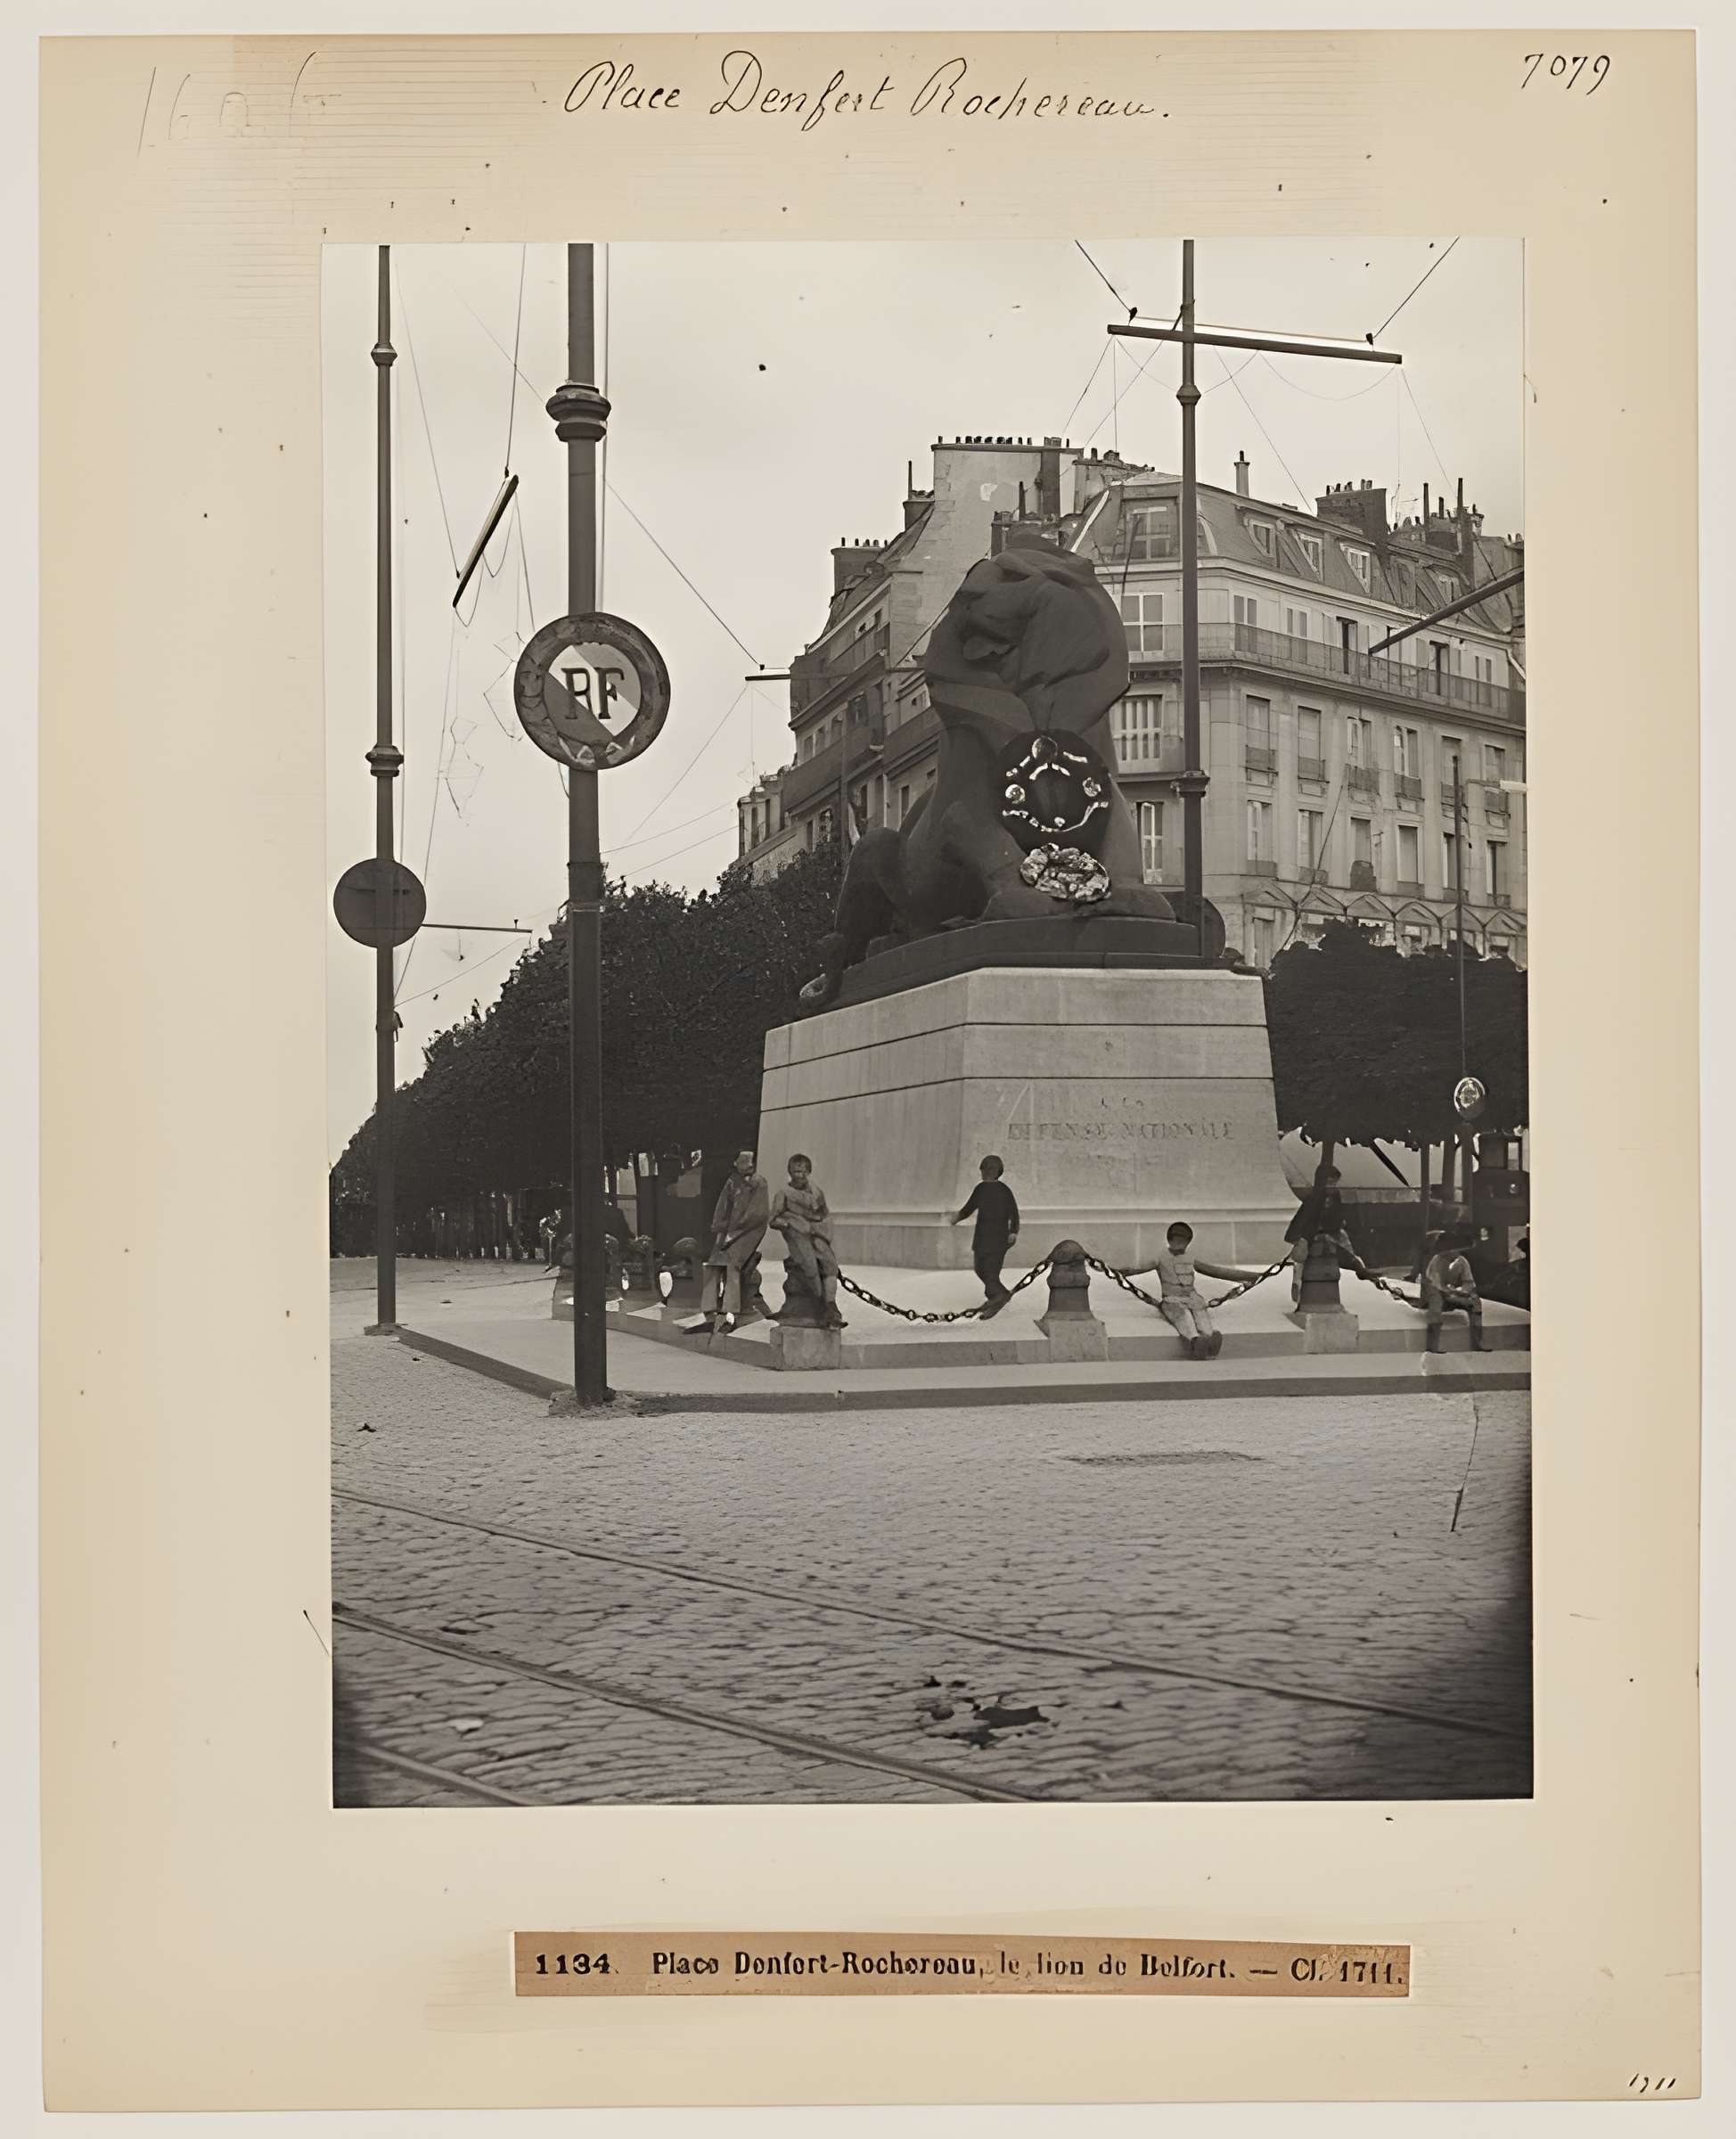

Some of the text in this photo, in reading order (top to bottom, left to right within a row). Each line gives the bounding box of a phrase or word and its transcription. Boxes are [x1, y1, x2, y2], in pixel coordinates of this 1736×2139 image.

[563, 61, 682, 114] Place
[708, 50, 895, 132] Denfert
[1521, 53, 1611, 95] 7079
[560, 666, 626, 720] RF
[1037, 1952, 1084, 1976] lion
